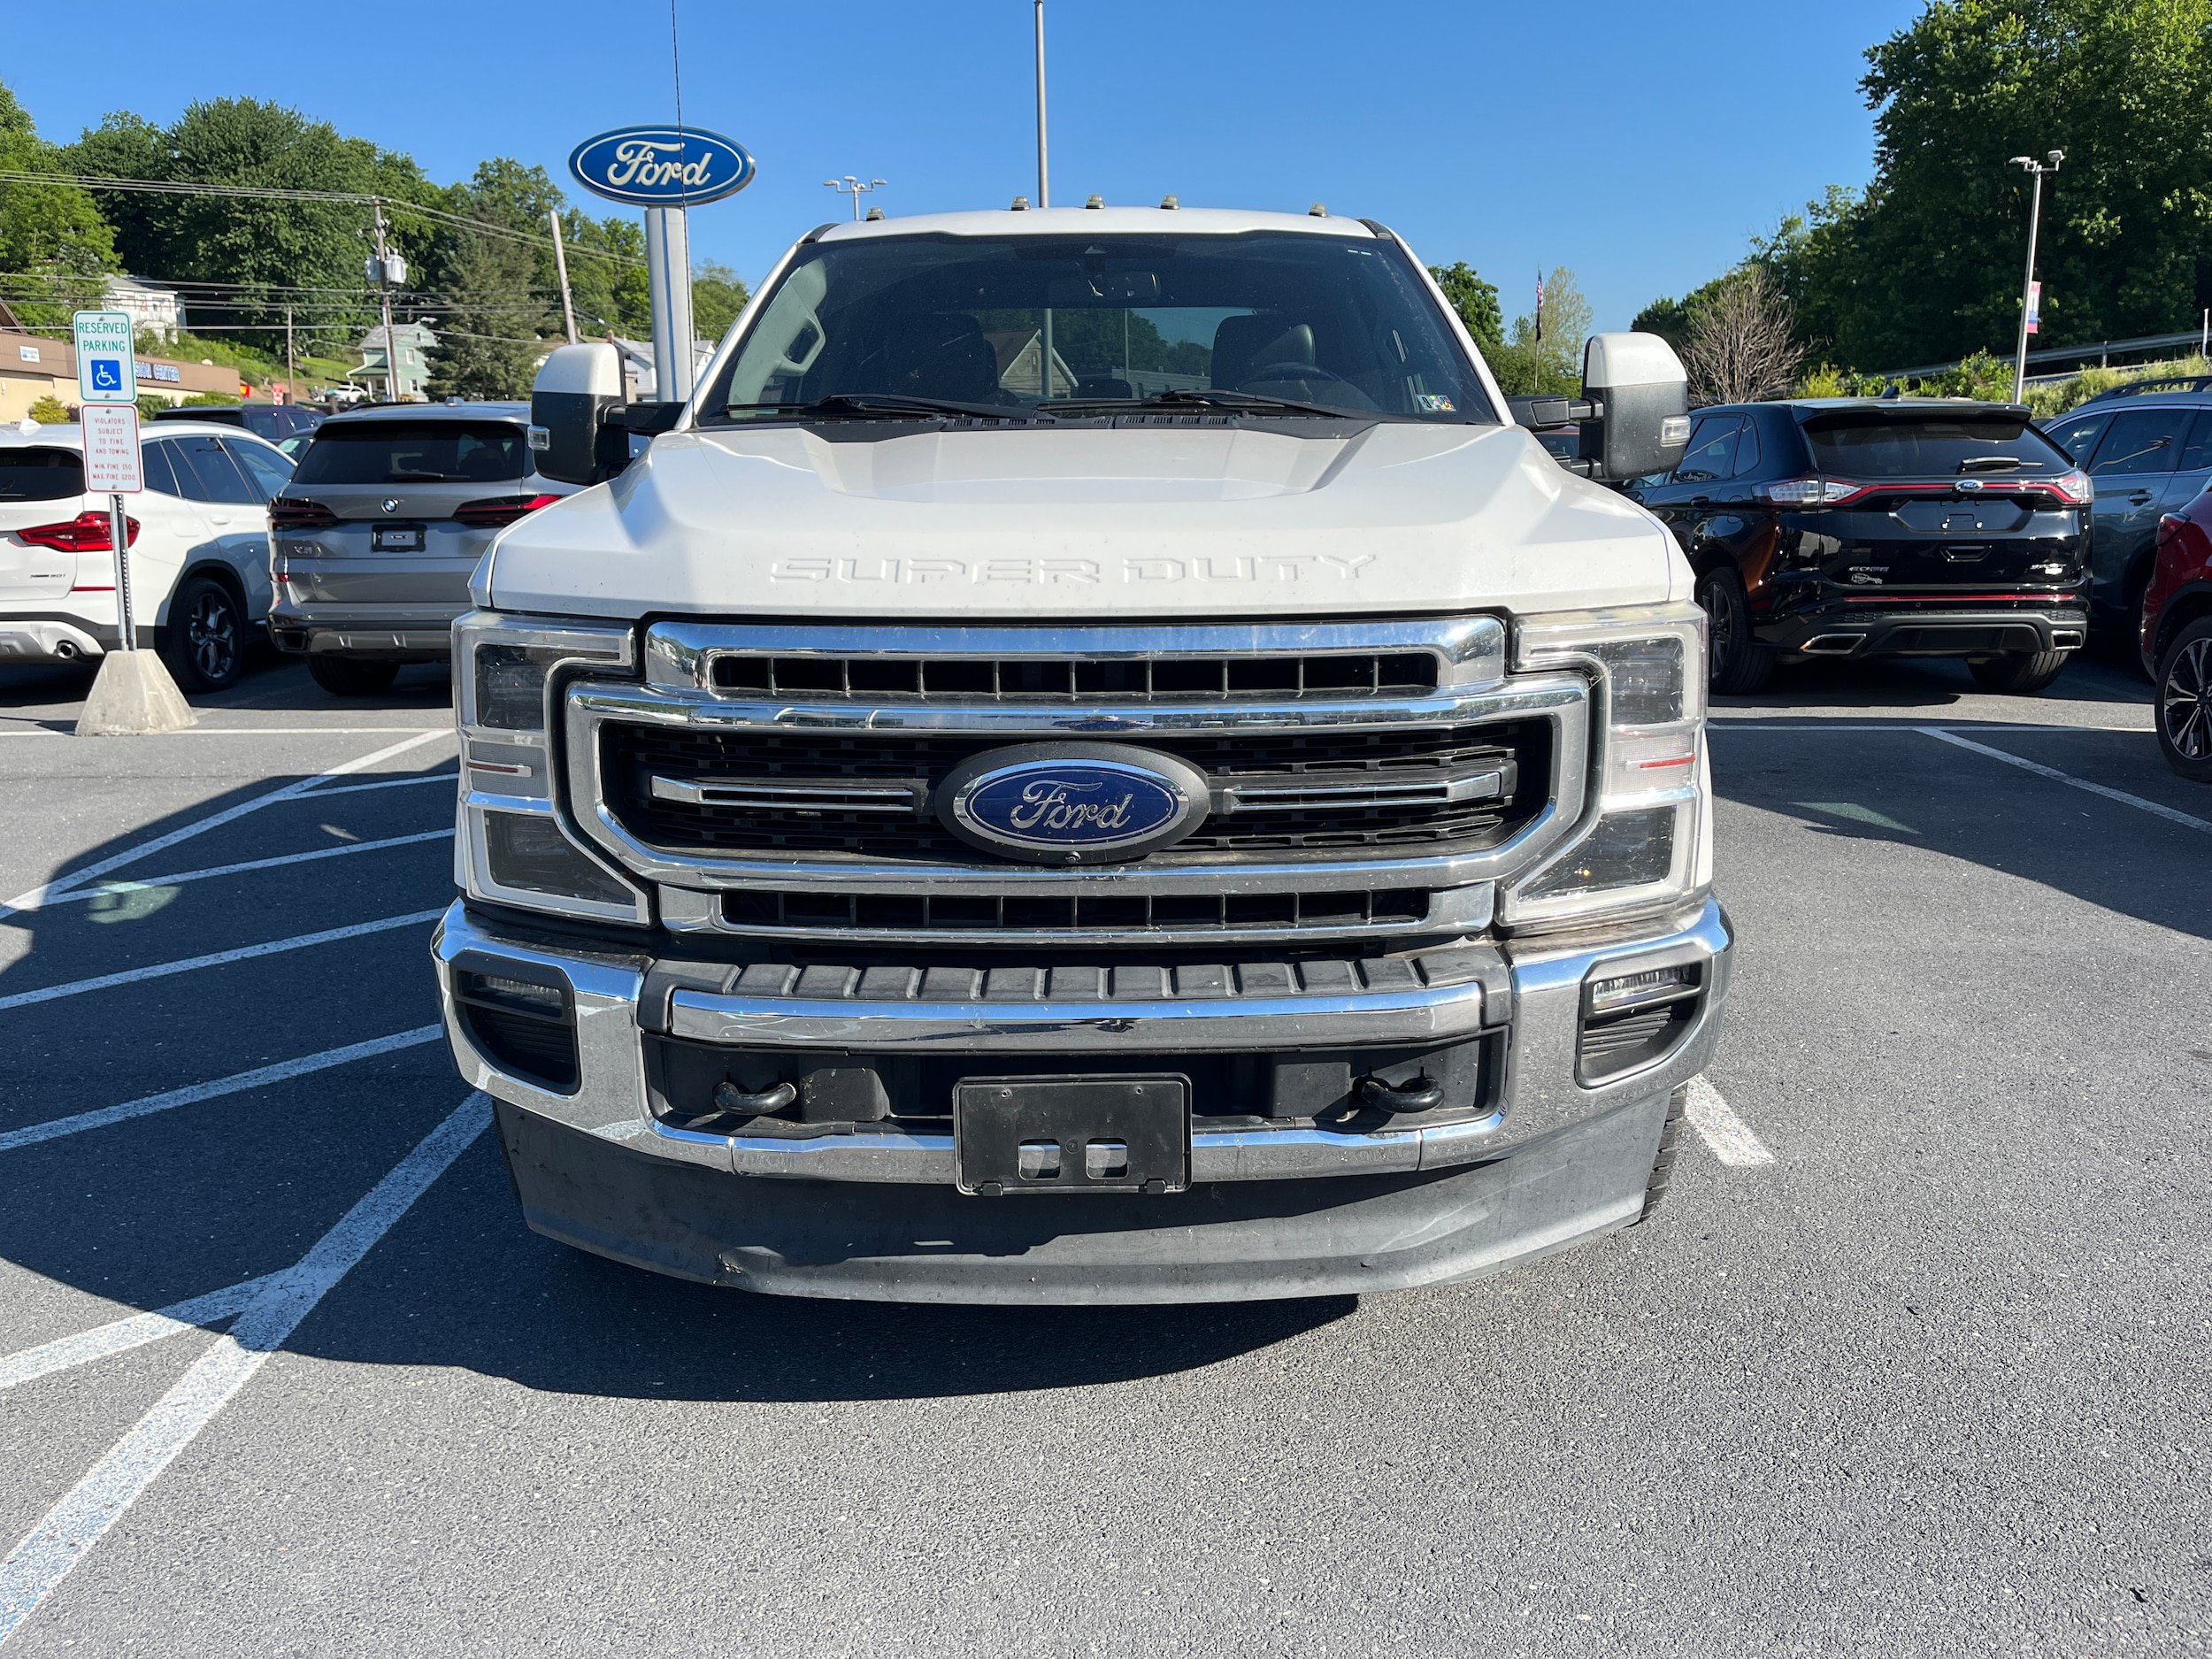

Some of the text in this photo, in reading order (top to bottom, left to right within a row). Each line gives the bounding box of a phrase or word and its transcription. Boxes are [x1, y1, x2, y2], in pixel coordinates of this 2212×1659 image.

[607, 140, 713, 186] Ford
[79, 322, 127, 334] RESERVED
[83, 340, 126, 351] PARKING
[770, 555, 1377, 584] SUPER DUTY
[1009, 780, 1133, 829] Ford
